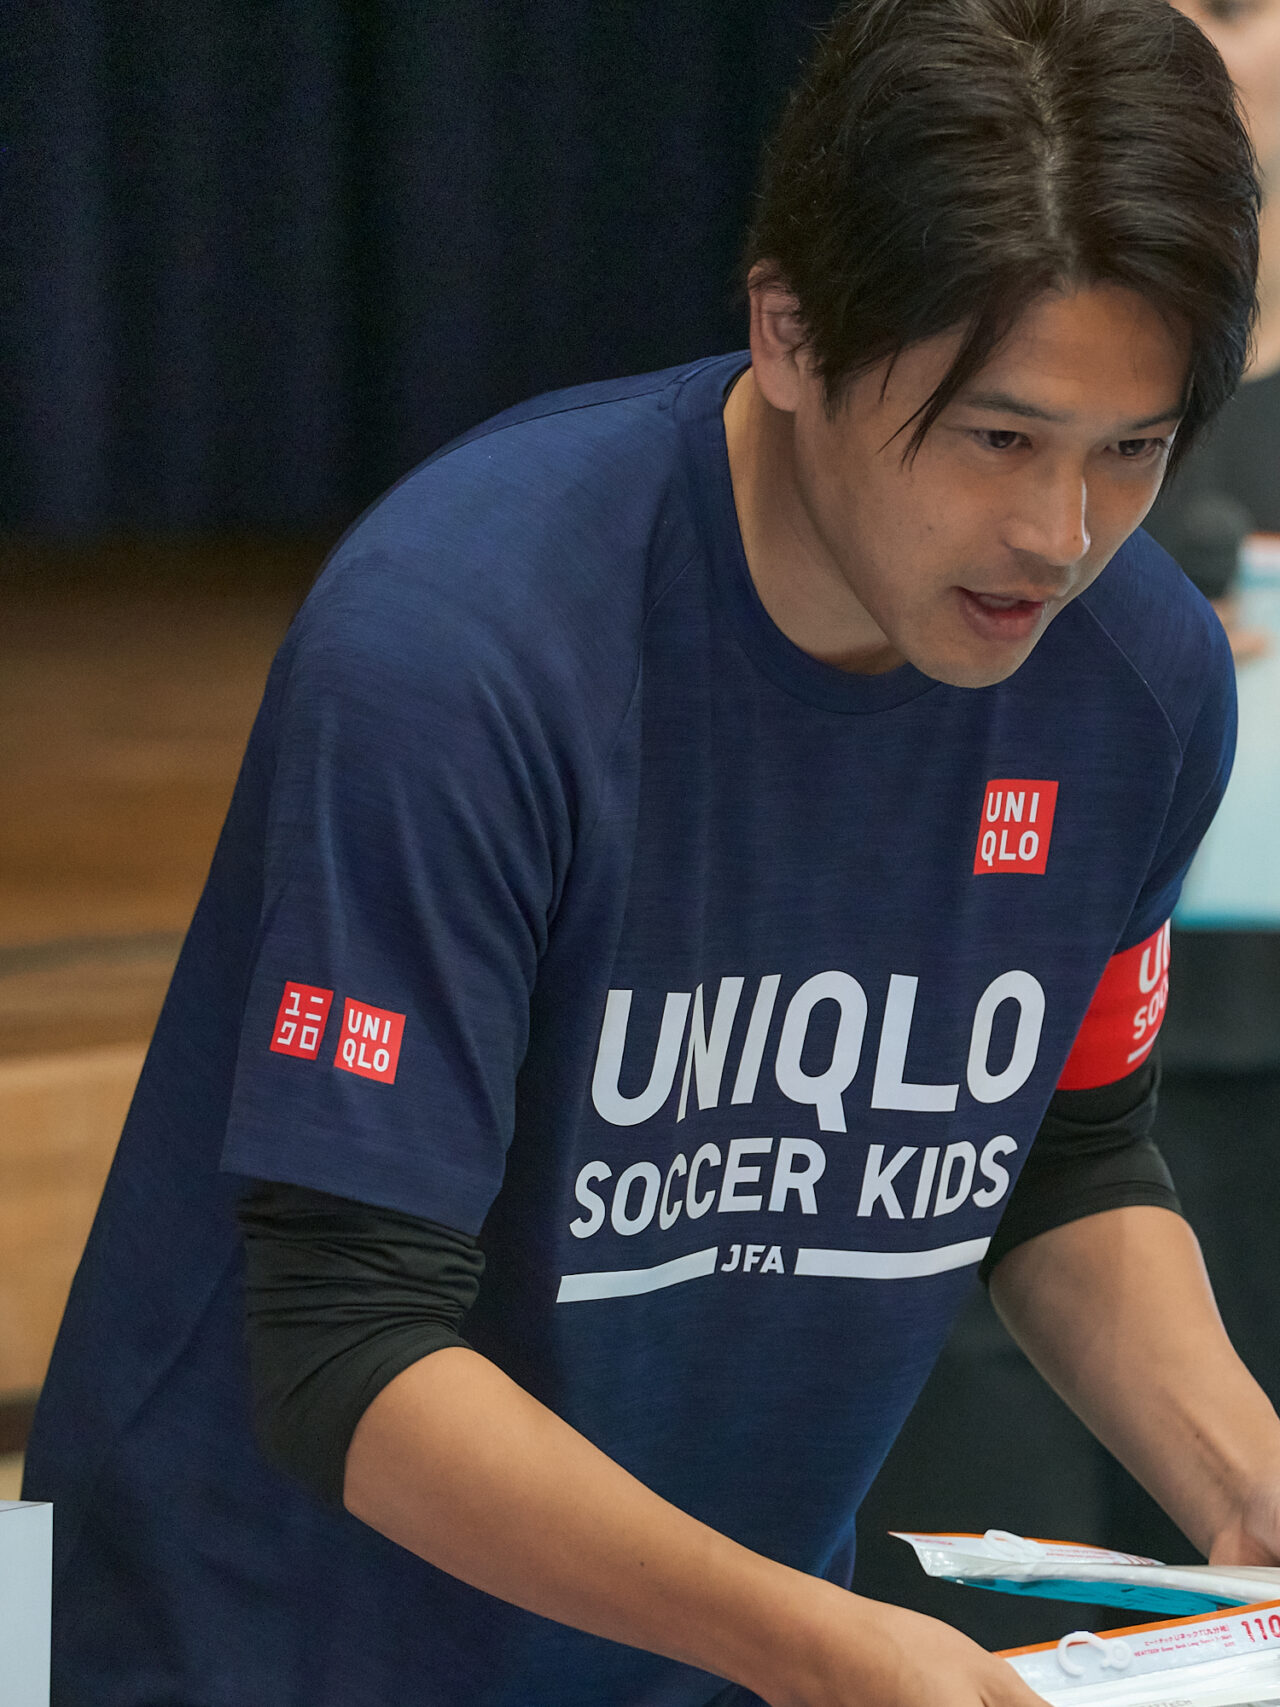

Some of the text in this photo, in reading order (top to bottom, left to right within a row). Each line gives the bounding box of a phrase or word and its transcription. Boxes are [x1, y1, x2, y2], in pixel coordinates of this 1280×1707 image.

[986, 791, 1040, 823] UNI
[981, 829, 1040, 867] QLO
[347, 1008, 392, 1044] UNI
[342, 1038, 391, 1073] QLO
[590, 970, 1046, 1133] UNIQLO
[569, 1134, 1018, 1239] SOCCER KIDS
[721, 1244, 785, 1275] JFA
